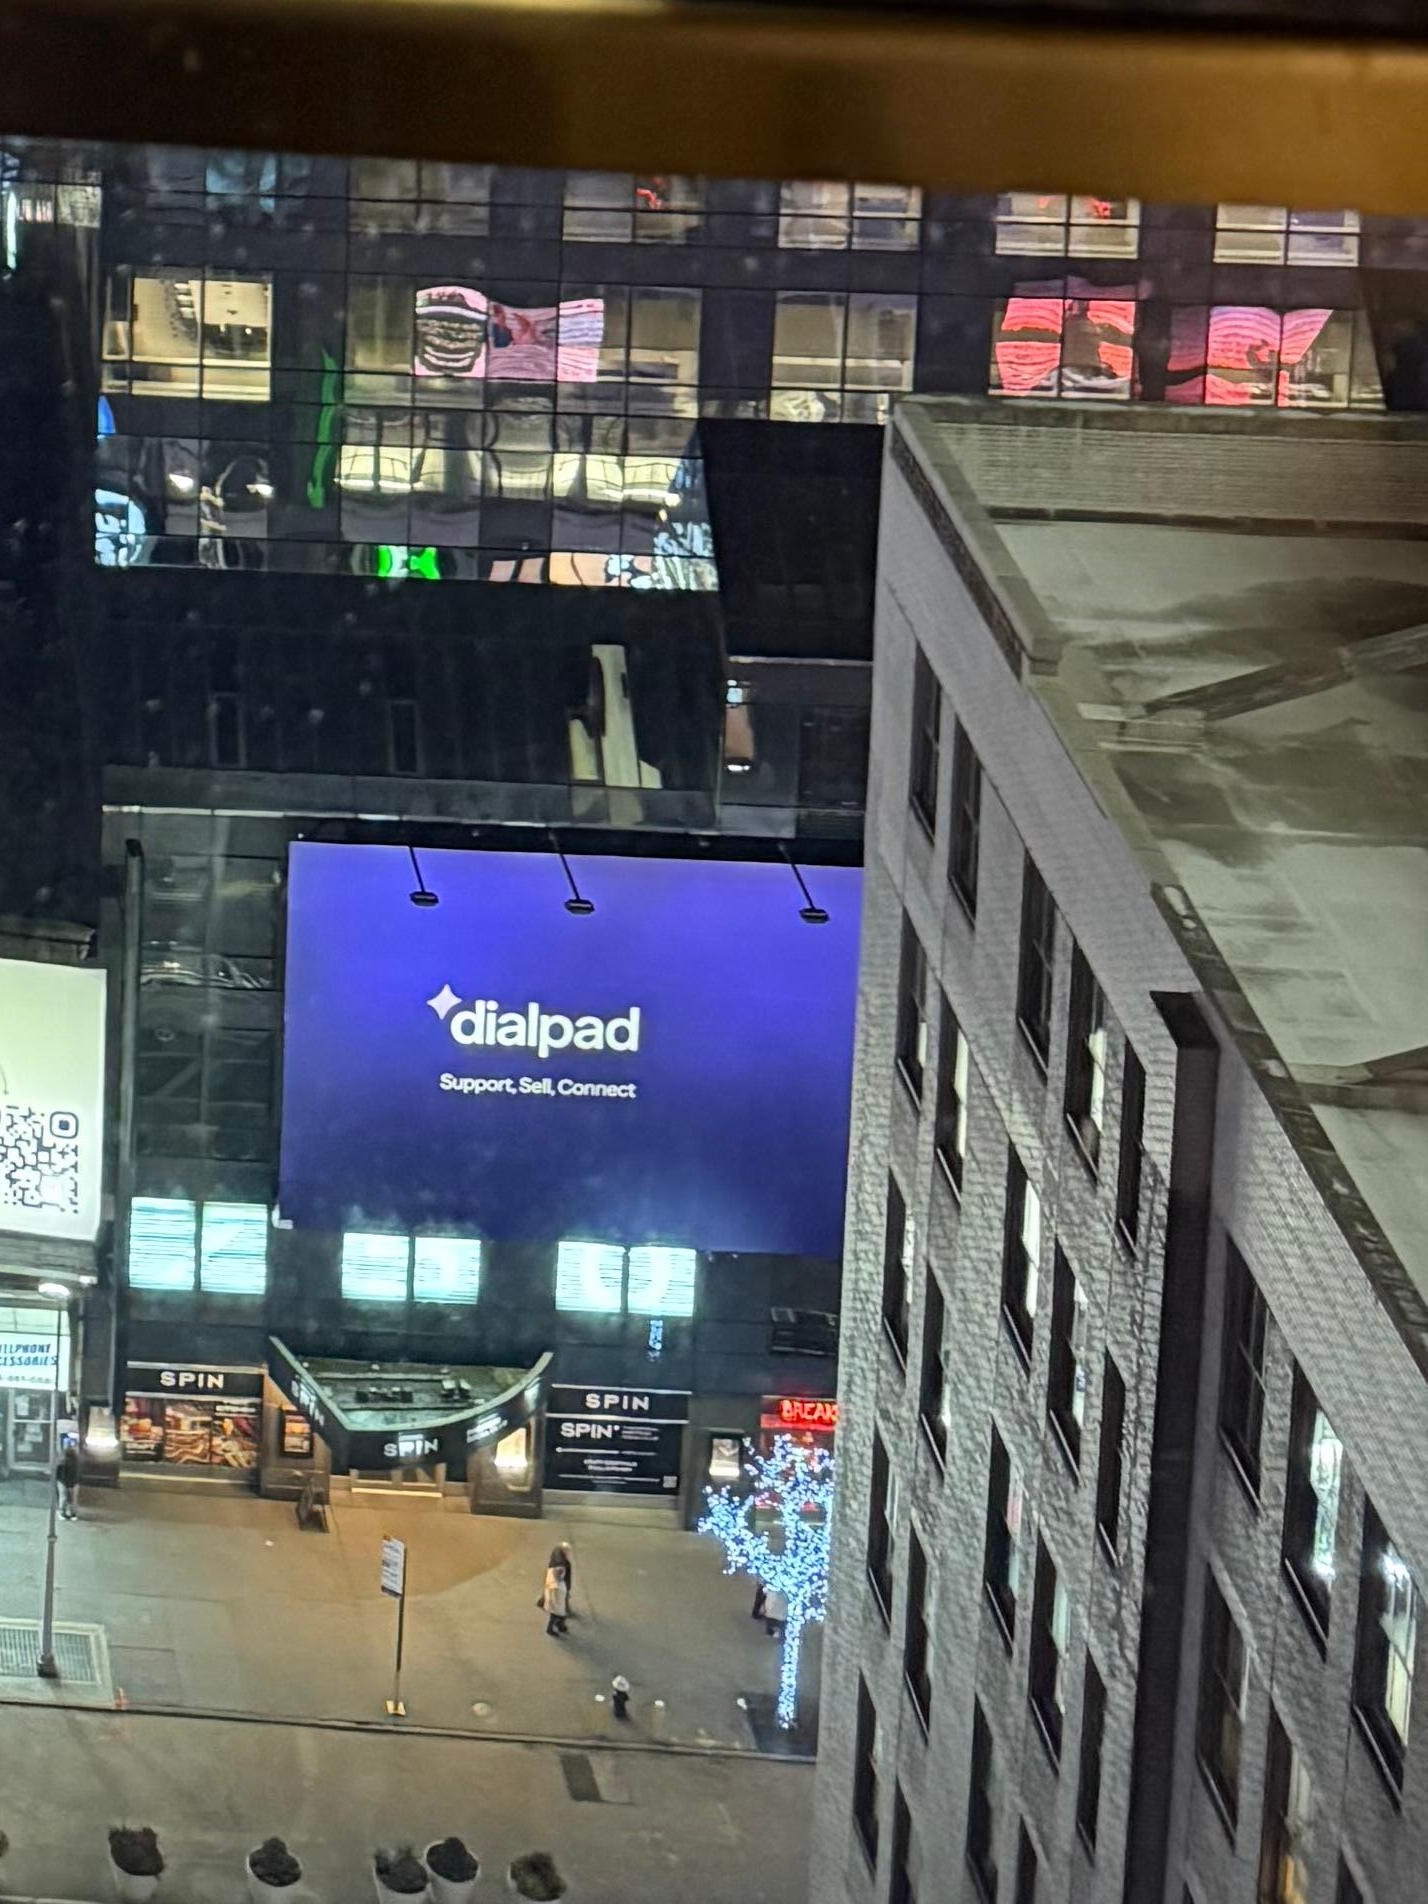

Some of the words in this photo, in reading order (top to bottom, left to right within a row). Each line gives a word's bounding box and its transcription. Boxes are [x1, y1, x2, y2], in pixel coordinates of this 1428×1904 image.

[449, 999, 641, 1059] dialpad
[439, 1072, 518, 1095] Support,
[518, 1076, 556, 1097] Sell,
[556, 1078, 637, 1099] Connect
[159, 1370, 225, 1390] SPIN
[584, 1392, 650, 1411] SPIN
